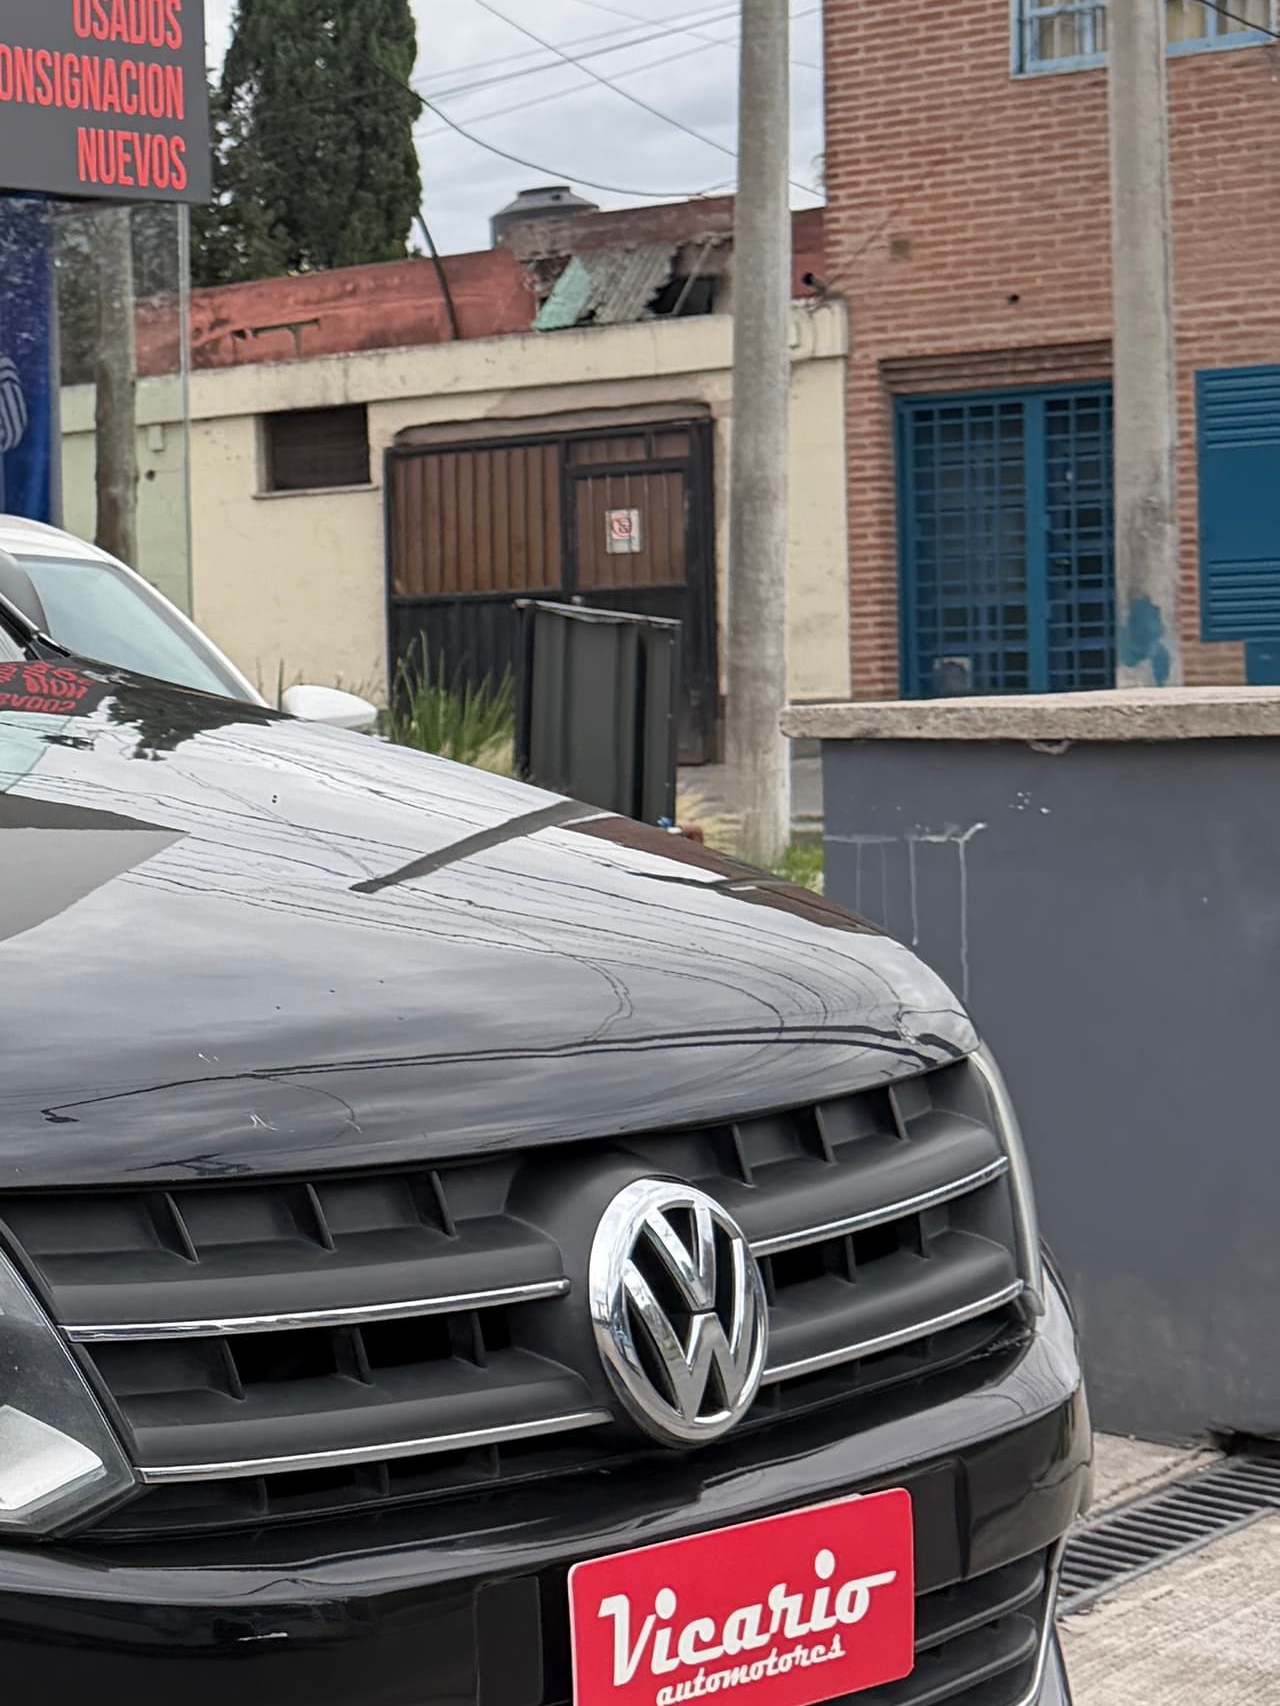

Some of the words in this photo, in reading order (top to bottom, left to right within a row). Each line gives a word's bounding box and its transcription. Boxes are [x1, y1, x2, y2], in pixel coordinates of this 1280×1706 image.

[77, 127, 187, 190] NUEVOS
[598, 1549, 897, 1686] Vicario
[655, 1634, 846, 1706] automotores
